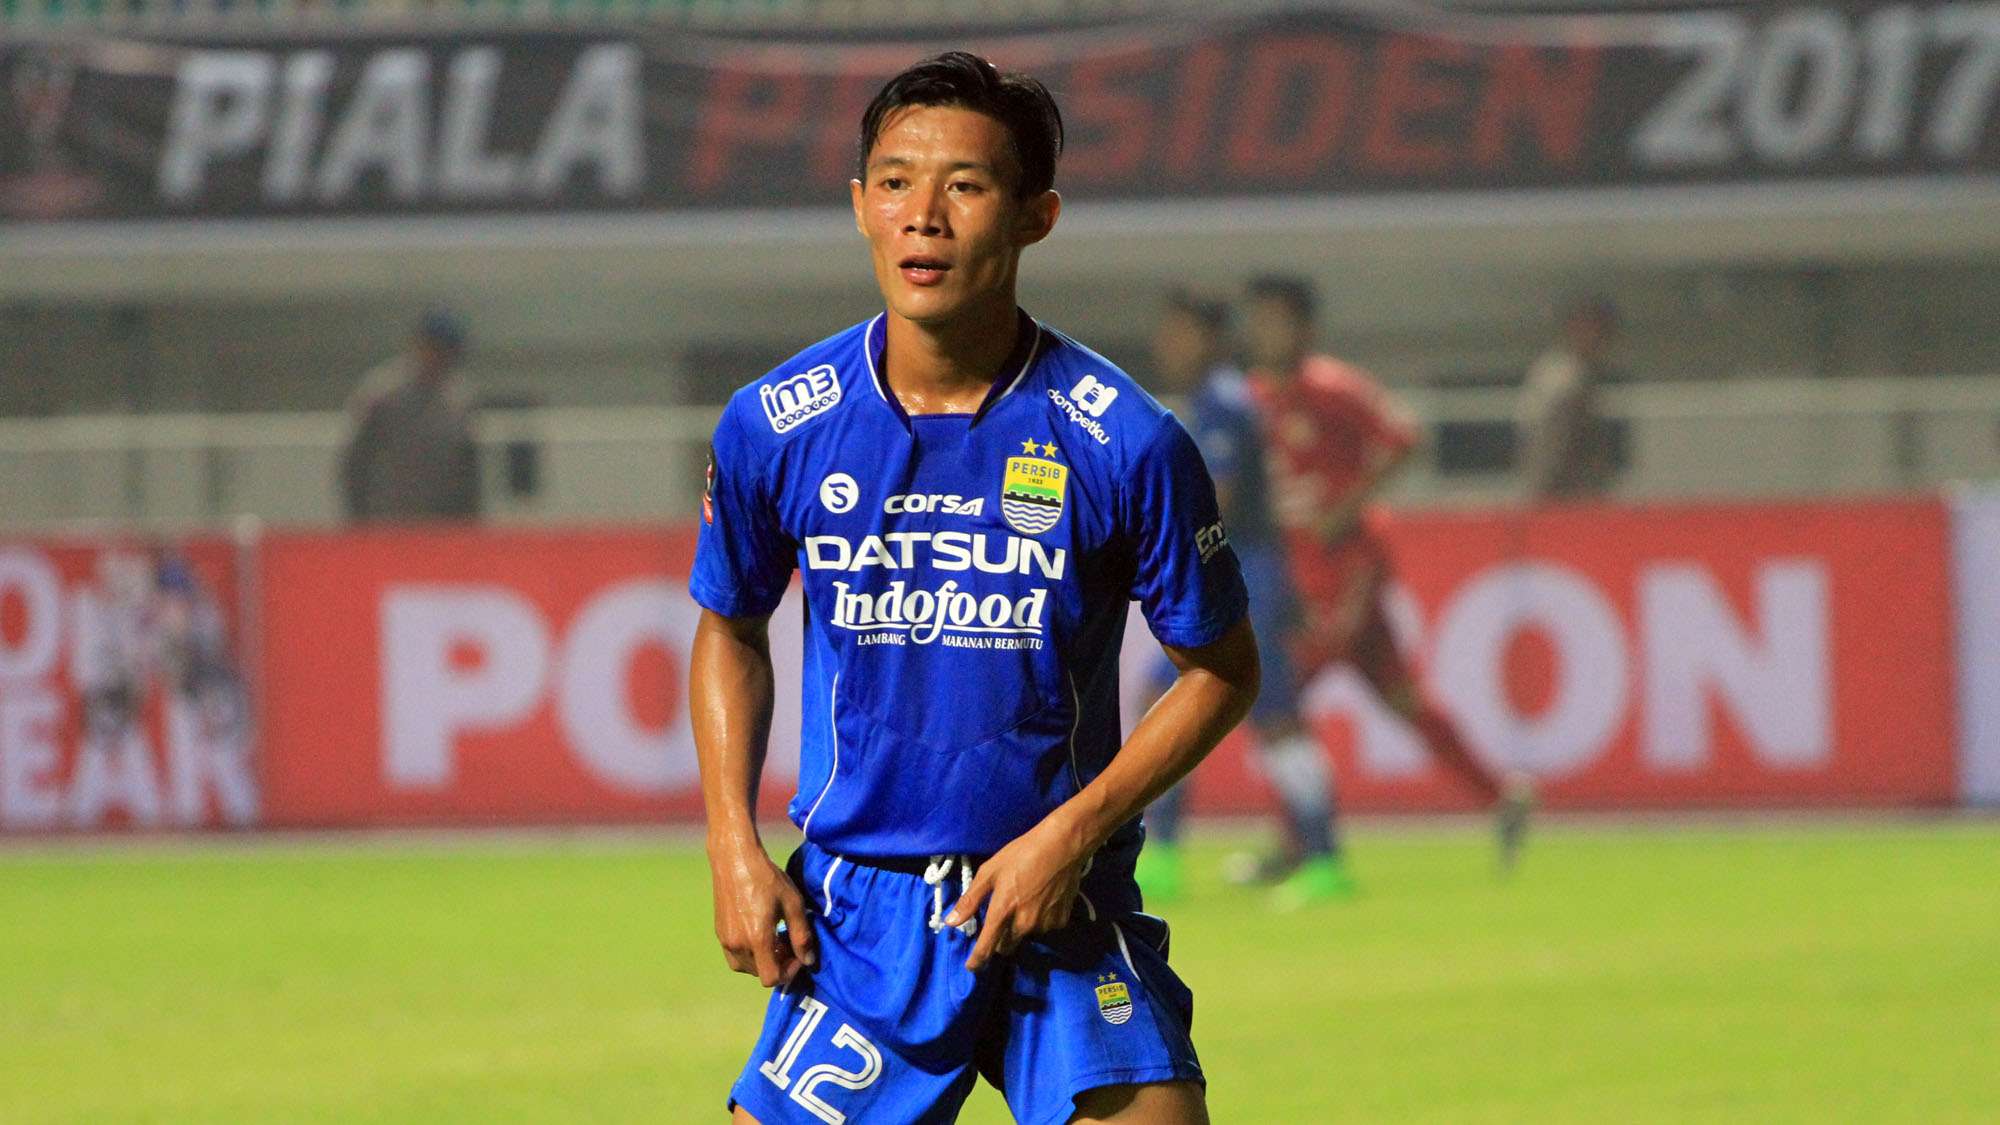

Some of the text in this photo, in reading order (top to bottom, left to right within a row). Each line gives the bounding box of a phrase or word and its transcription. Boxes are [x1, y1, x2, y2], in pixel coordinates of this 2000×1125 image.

[158, 46, 646, 202] PIALA
[1628, 10, 2000, 166] 2017
[1012, 462, 1060, 479] PERSIB
[805, 531, 1066, 580] DATSUN
[831, 580, 1048, 645] Indofood
[857, 633, 1044, 651] LAMBANG MAKANAN BERMUTU
[759, 995, 884, 1125] 12
